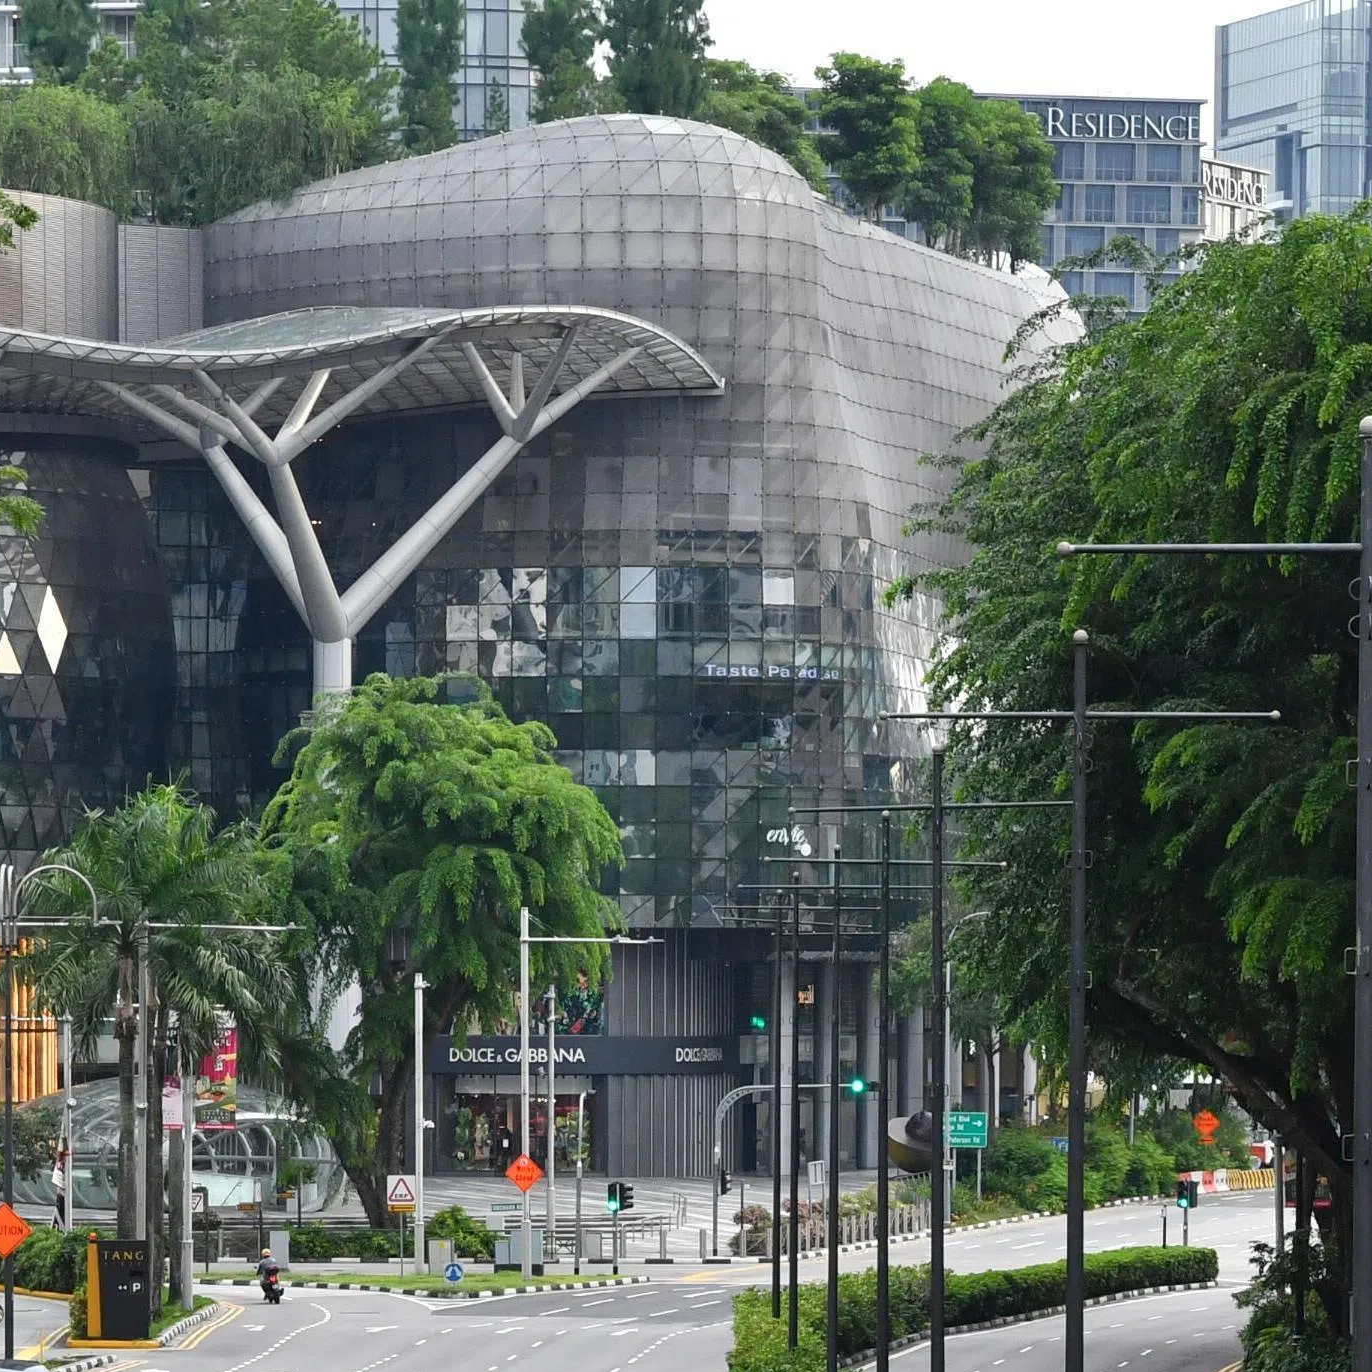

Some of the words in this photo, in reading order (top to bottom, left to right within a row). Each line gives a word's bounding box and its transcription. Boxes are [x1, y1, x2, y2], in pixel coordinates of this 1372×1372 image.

[704, 664, 759, 678] Taste
[768, 665, 840, 680] Paadse
[449, 1047, 495, 1063] DOLCE
[132, 1282, 141, 1293] P
